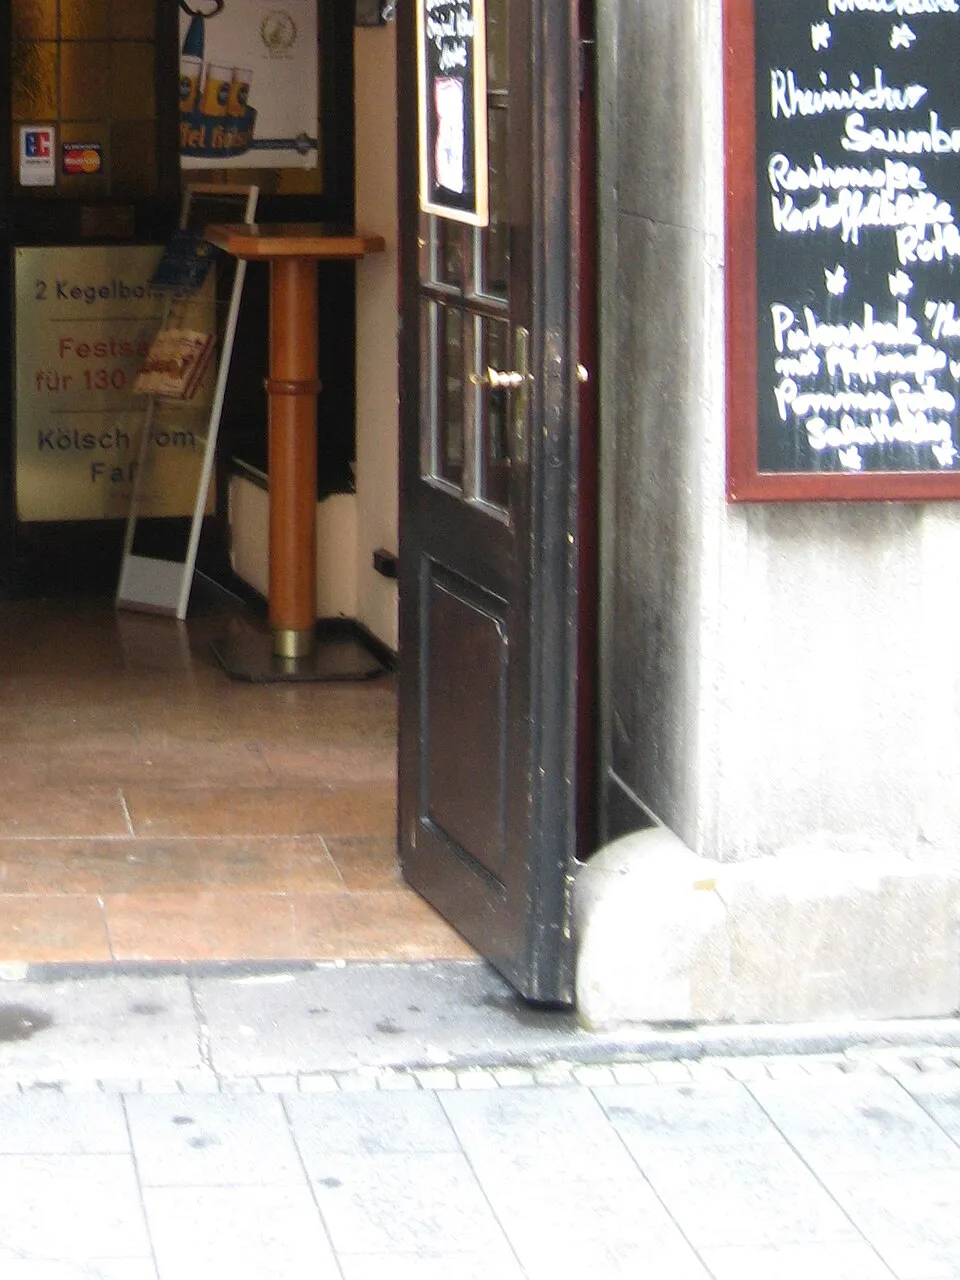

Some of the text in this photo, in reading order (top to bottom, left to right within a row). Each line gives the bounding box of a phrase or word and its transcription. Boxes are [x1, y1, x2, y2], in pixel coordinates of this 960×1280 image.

[34, 280, 47, 300] 2
[58, 336, 151, 359] Festsa
[34, 368, 128, 392] für 130
[37, 427, 131, 451] Kölsch
